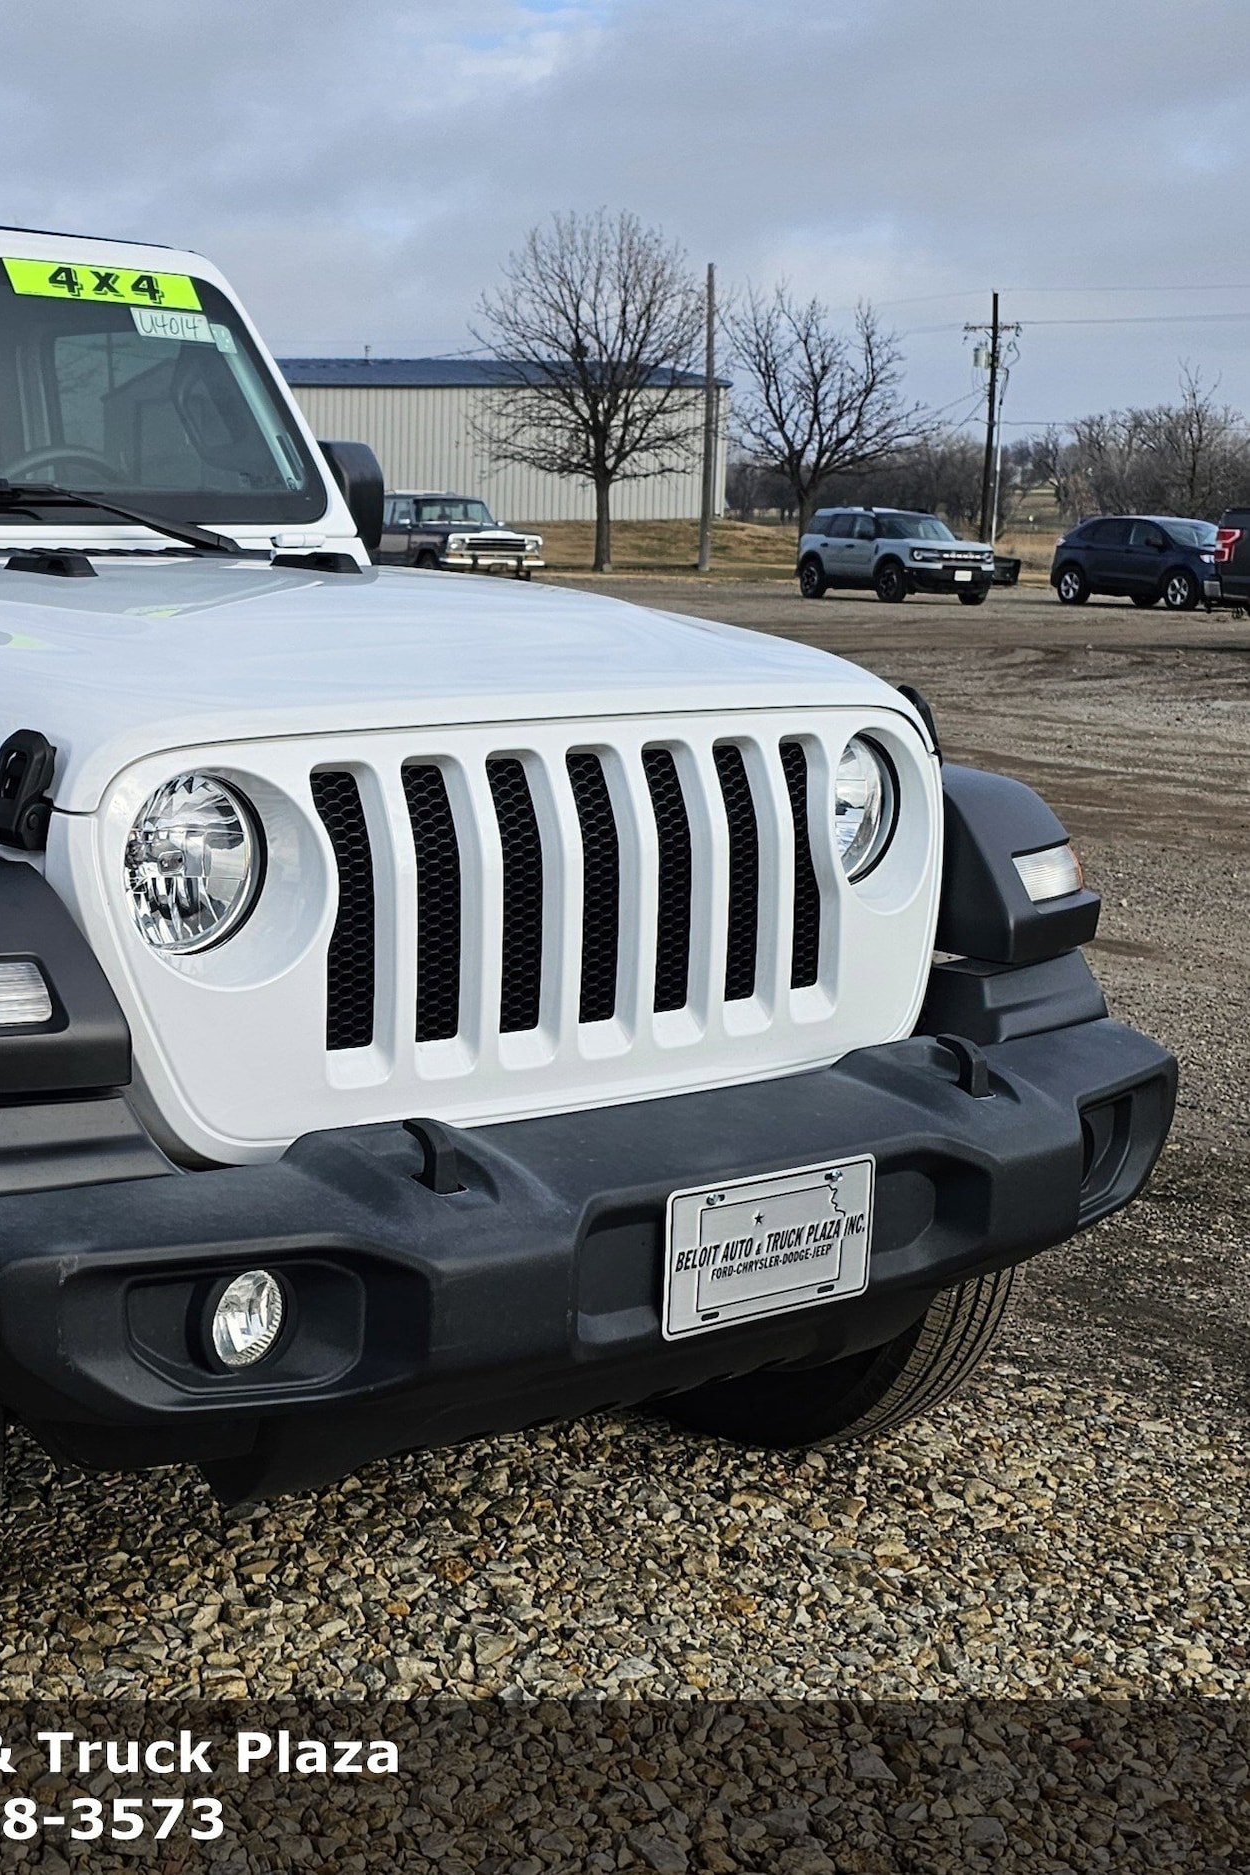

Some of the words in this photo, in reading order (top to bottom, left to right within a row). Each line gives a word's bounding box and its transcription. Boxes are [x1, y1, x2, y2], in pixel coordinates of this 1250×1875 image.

[675, 1245, 720, 1272] BELOIT
[721, 1238, 753, 1264] AUTO
[755, 1244, 761, 1255] &
[766, 1227, 804, 1253] TRUCK
[806, 1219, 841, 1245] PLAZA
[843, 1213, 865, 1237] INC.
